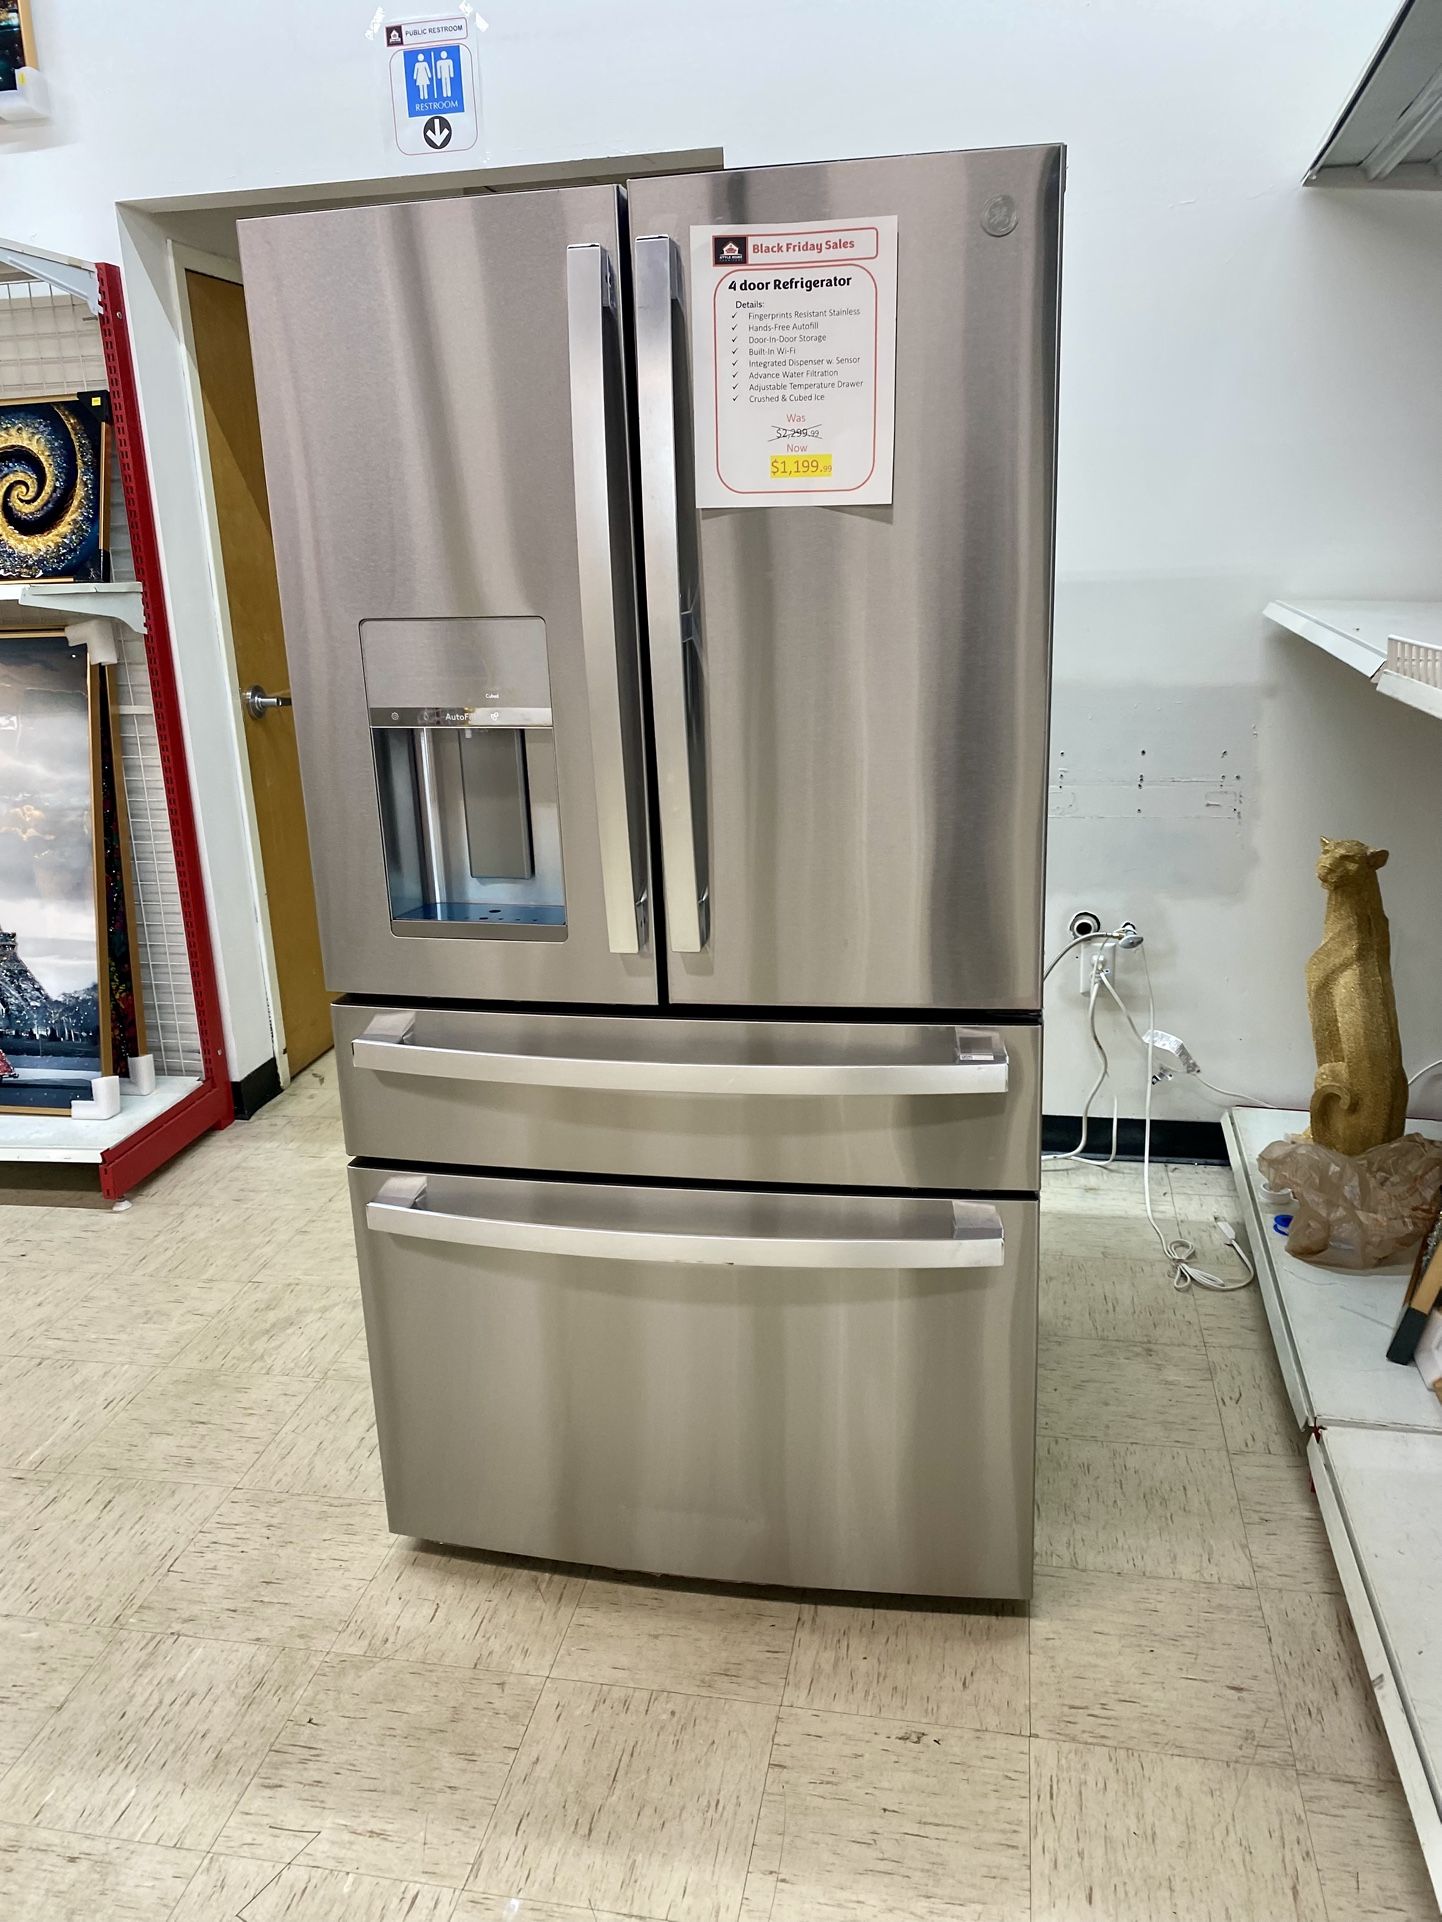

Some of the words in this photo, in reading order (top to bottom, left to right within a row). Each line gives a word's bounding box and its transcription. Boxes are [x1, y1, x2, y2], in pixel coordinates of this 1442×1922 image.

[405, 29, 427, 37] PUBLIC
[428, 24, 463, 34] RESTROOM
[415, 100, 459, 112] RESTROOM
[752, 243, 784, 253] Black
[786, 242, 823, 254] Friday
[824, 238, 855, 250] Sales
[728, 280, 737, 291] 4
[739, 279, 771, 291] door
[774, 276, 852, 291] Refrigerator
[735, 300, 764, 309] Details:
[748, 311, 793, 321] Fingerprints
[794, 310, 827, 318] Resistant
[829, 308, 861, 316] Stainless
[749, 323, 790, 332] Hands-Free
[792, 322, 819, 330] Autofill
[749, 335, 797, 343] Door-In-Door
[799, 334, 827, 343] Storage
[749, 347, 774, 355] Built-In
[776, 347, 796, 355] Wi-Fi
[749, 359, 787, 369] Integrated
[788, 358, 824, 368] Dispenser
[836, 356, 861, 364] Sensor
[749, 371, 780, 379] Advance
[781, 370, 804, 378] Water
[806, 369, 838, 377] Filtration
[749, 383, 788, 392] Adjustable
[789, 381, 836, 391] Temperature
[837, 380, 864, 388] Drawer
[749, 395, 779, 403] Crushed
[781, 394, 787, 402] &
[789, 394, 813, 402] Cubed
[814, 393, 825, 401] Ice
[786, 413, 806, 423] Was
[786, 443, 808, 453] Now
[771, 459, 832, 476] $1,199.99
